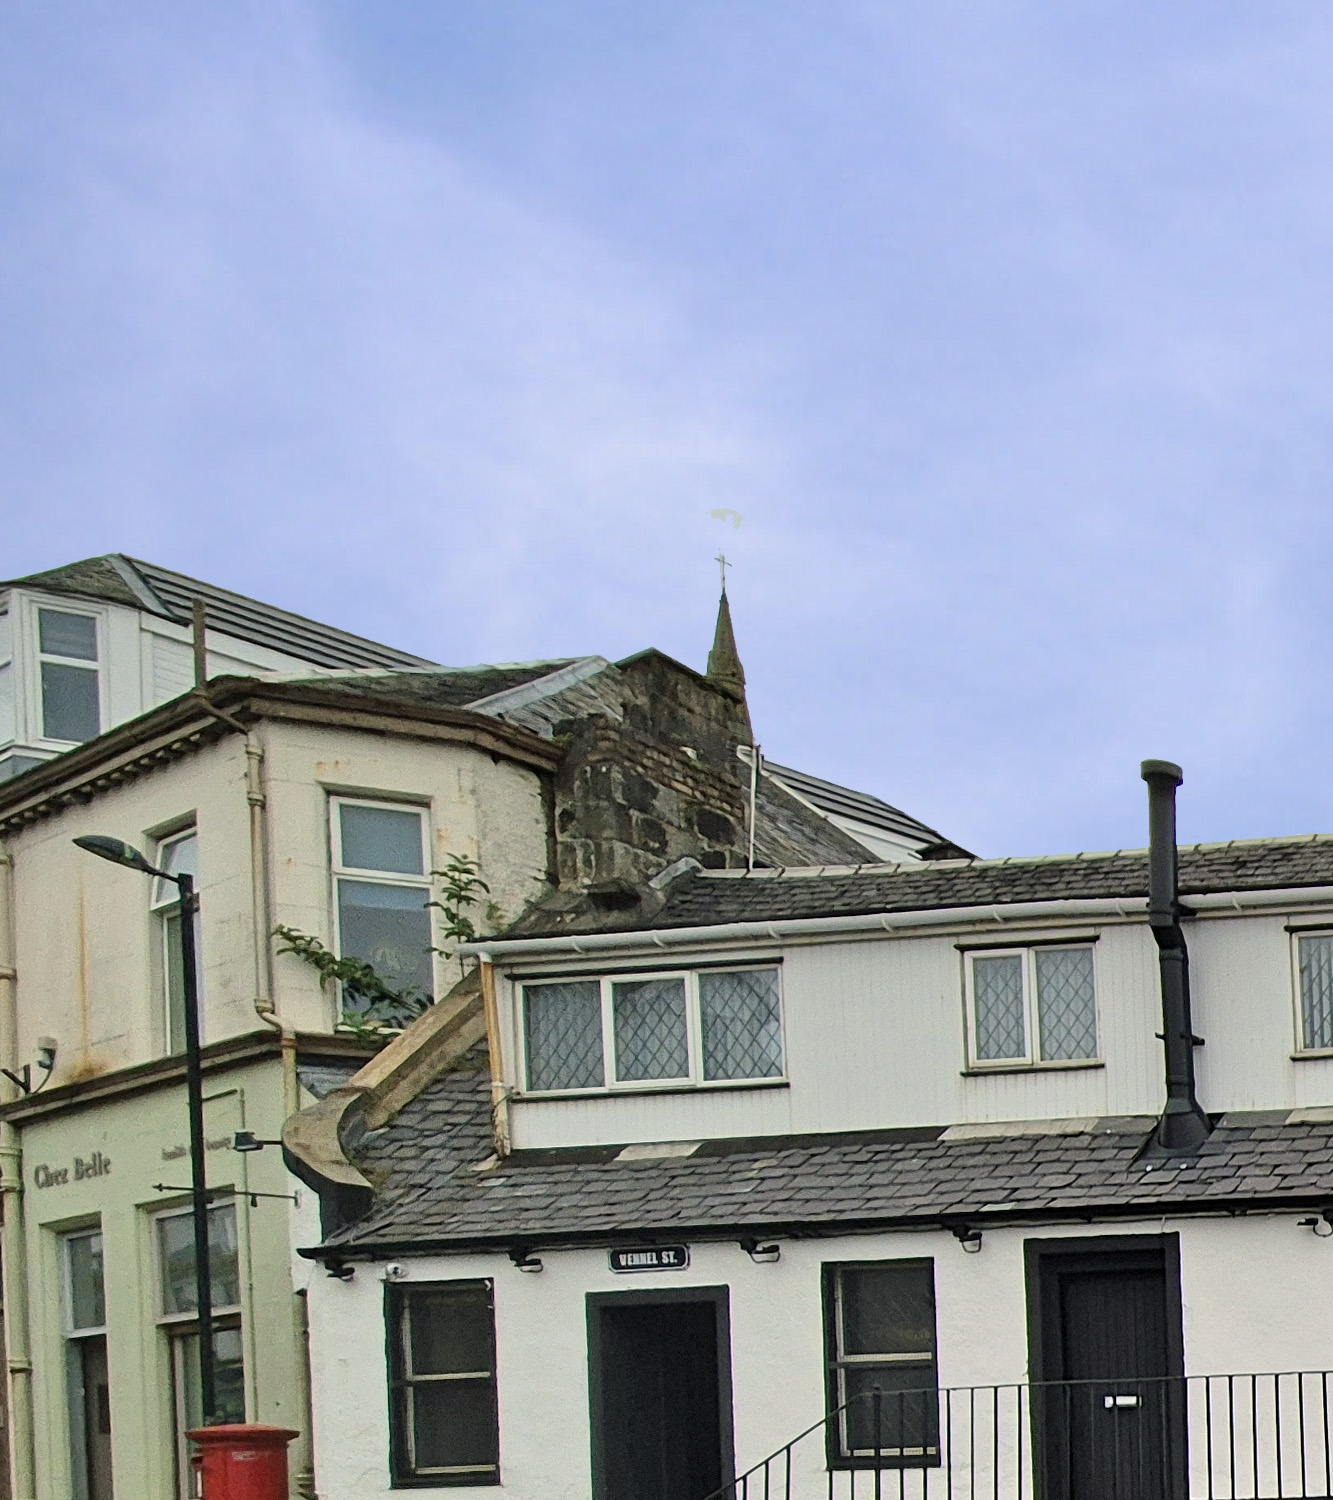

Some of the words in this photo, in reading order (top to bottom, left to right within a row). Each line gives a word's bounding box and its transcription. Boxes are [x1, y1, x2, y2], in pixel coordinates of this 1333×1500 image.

[34, 1163, 69, 1189] Chez
[74, 1151, 112, 1181] Belle
[619, 1252, 659, 1267] VENNEL
[661, 1251, 678, 1264] ST.
